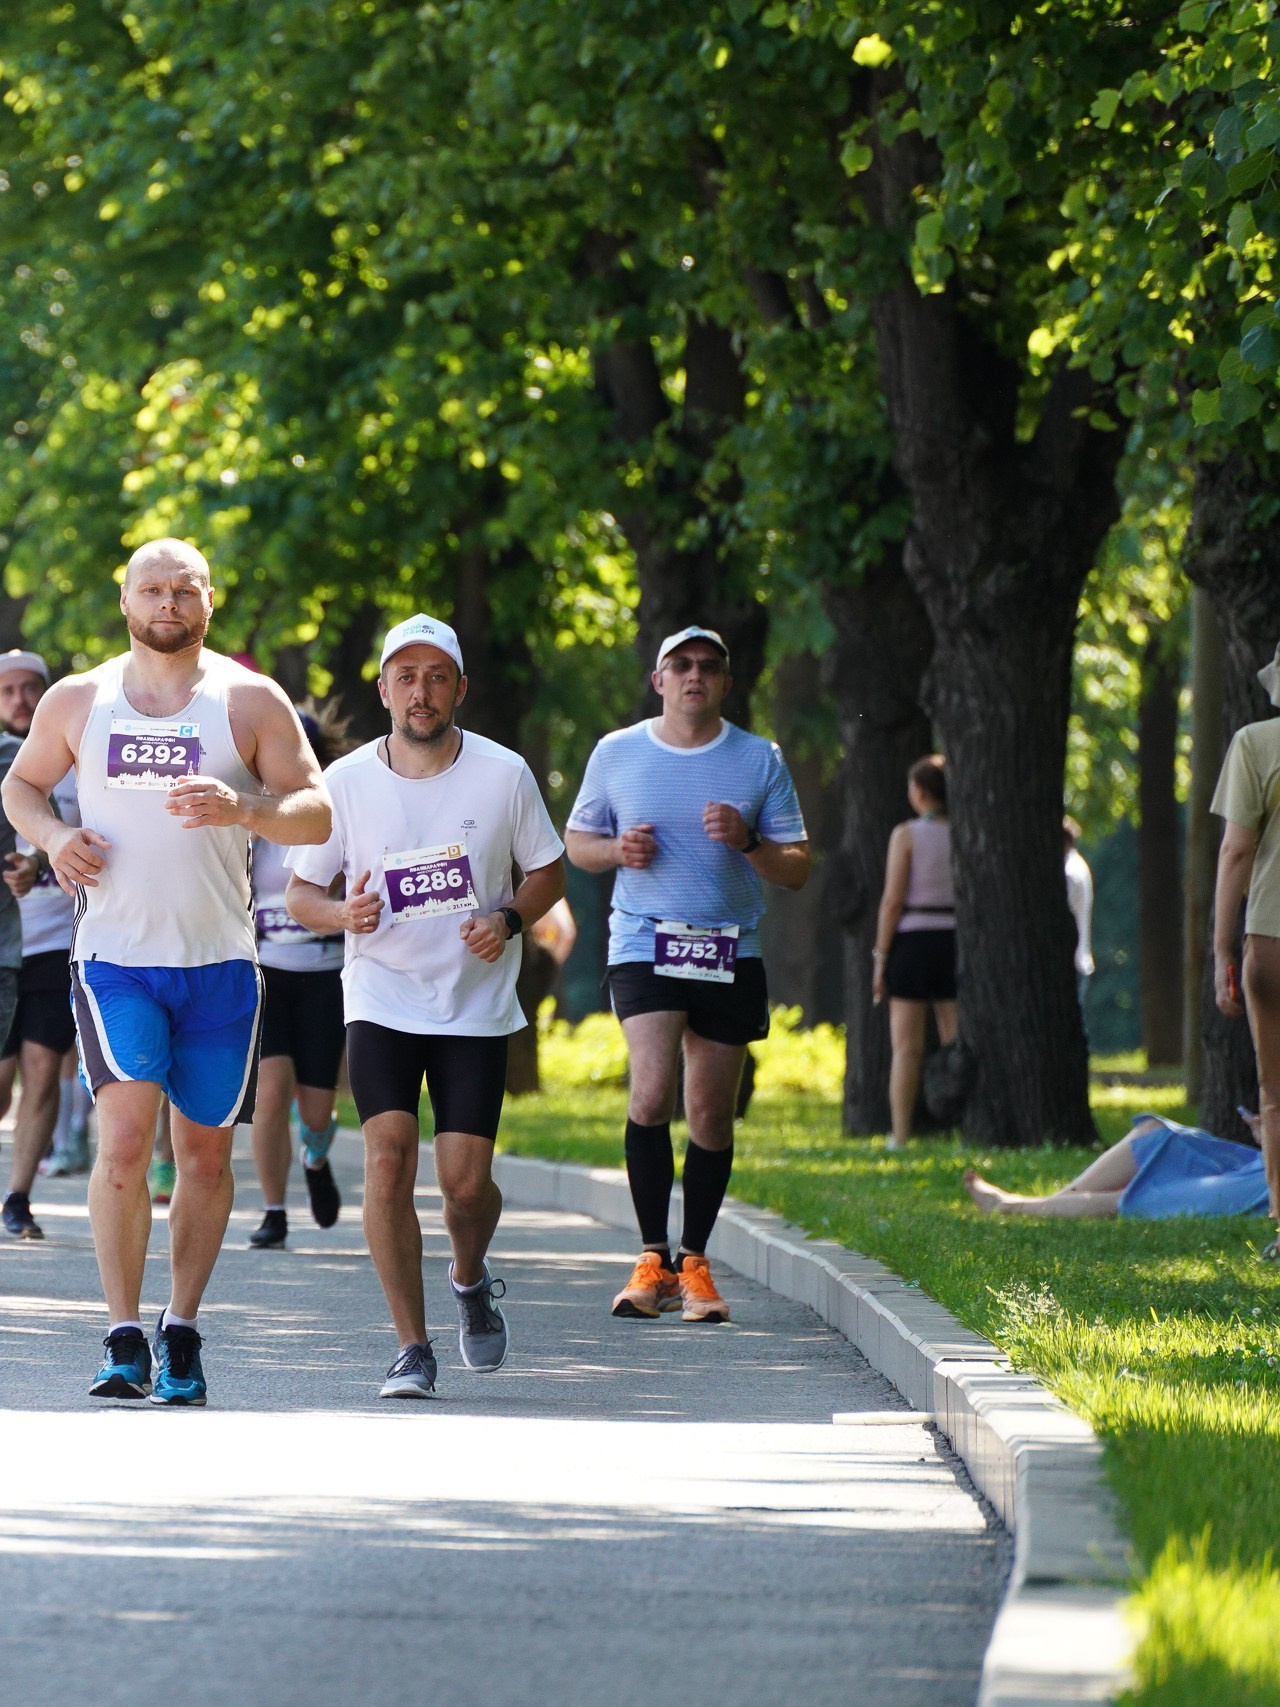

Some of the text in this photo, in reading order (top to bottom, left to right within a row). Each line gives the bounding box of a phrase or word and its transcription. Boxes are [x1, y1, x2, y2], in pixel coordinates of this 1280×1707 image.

[121, 743, 187, 765] 6292
[449, 846, 459, 855] D
[399, 868, 464, 897] 6286
[665, 940, 718, 960] 5752
